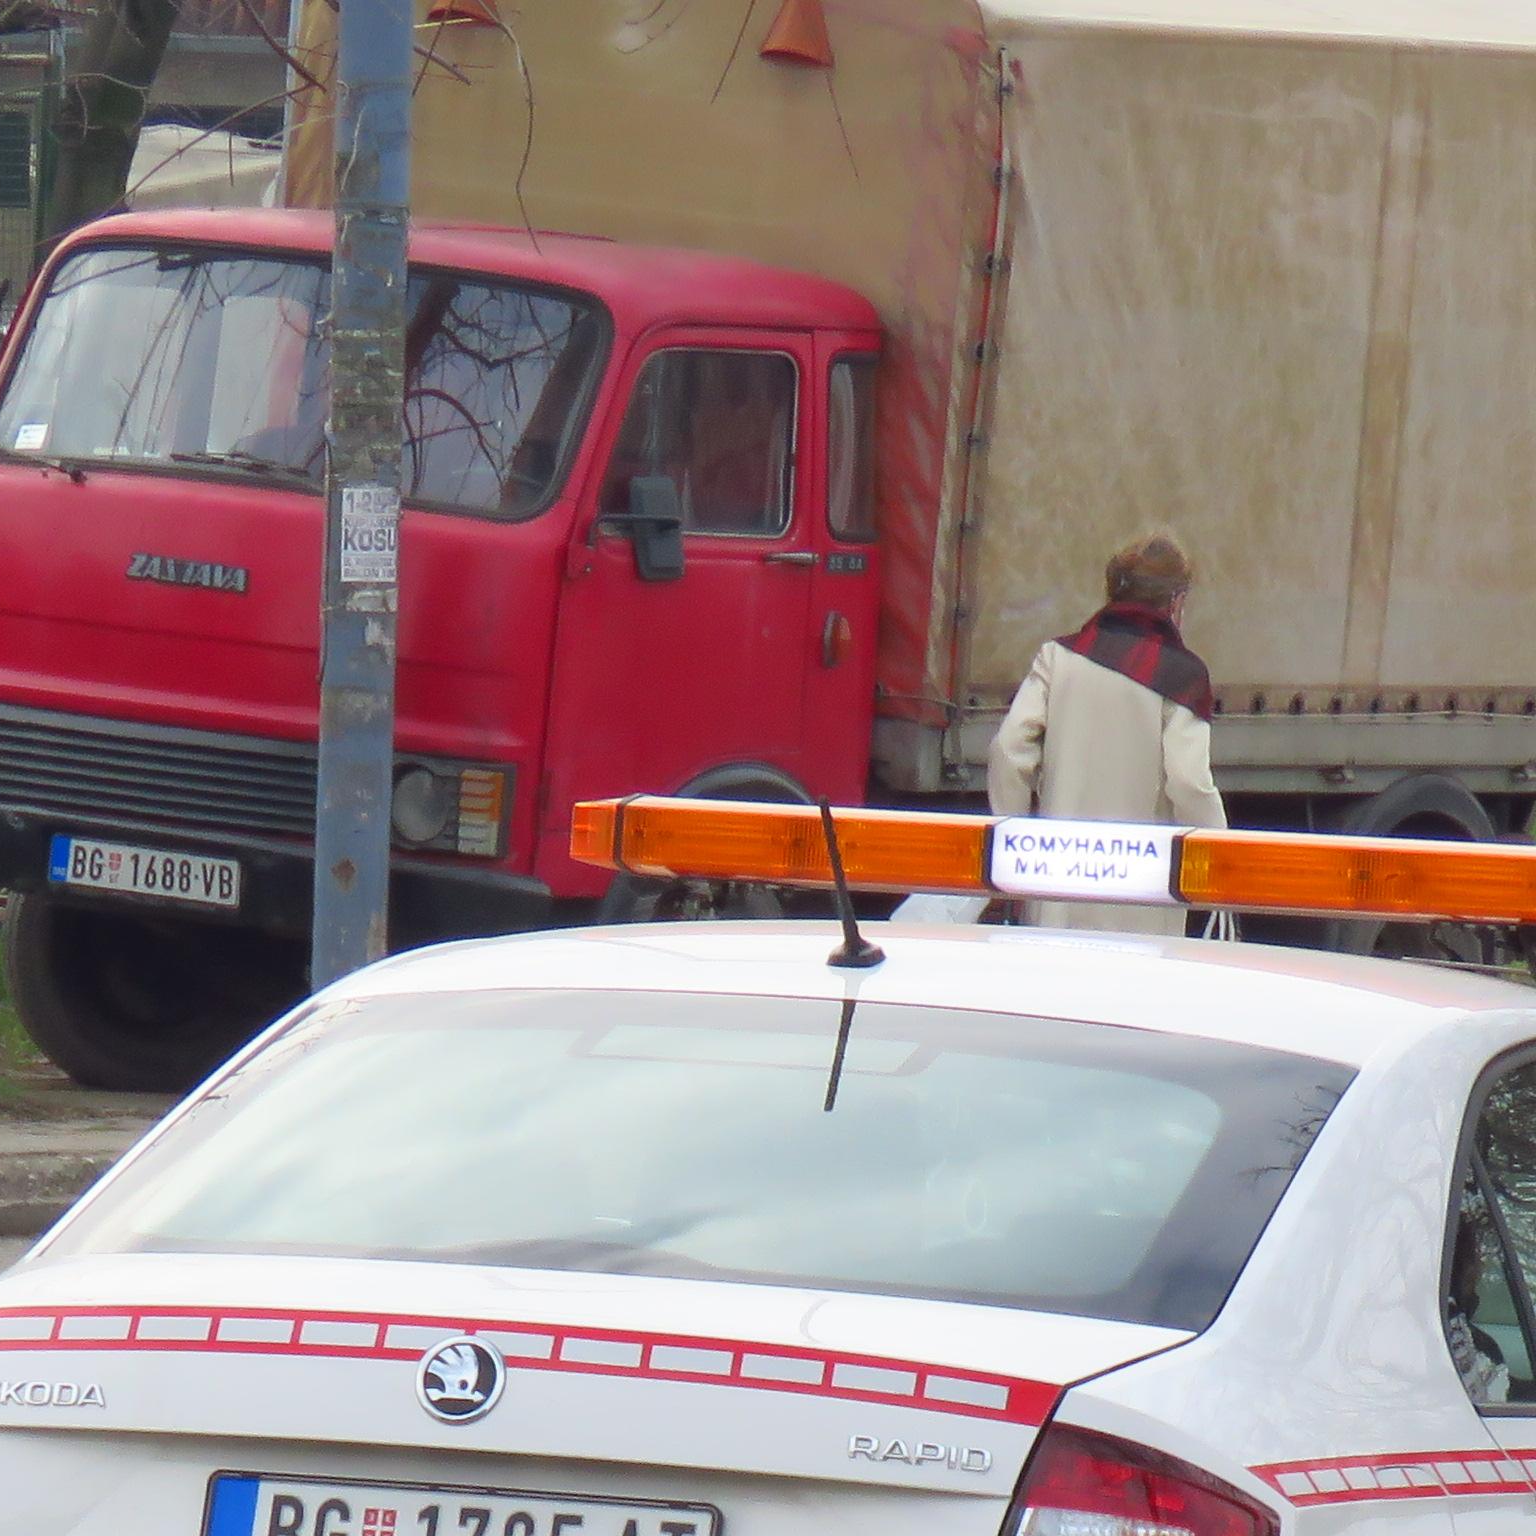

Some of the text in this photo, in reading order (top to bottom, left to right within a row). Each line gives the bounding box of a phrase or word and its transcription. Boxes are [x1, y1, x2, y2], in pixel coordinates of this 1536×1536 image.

[126, 552, 248, 593] ZASTAVA
[72, 845, 105, 880] BG
[1004, 833, 1159, 858] КОМУНАЛНА
[848, 1434, 994, 1473] RAPID
